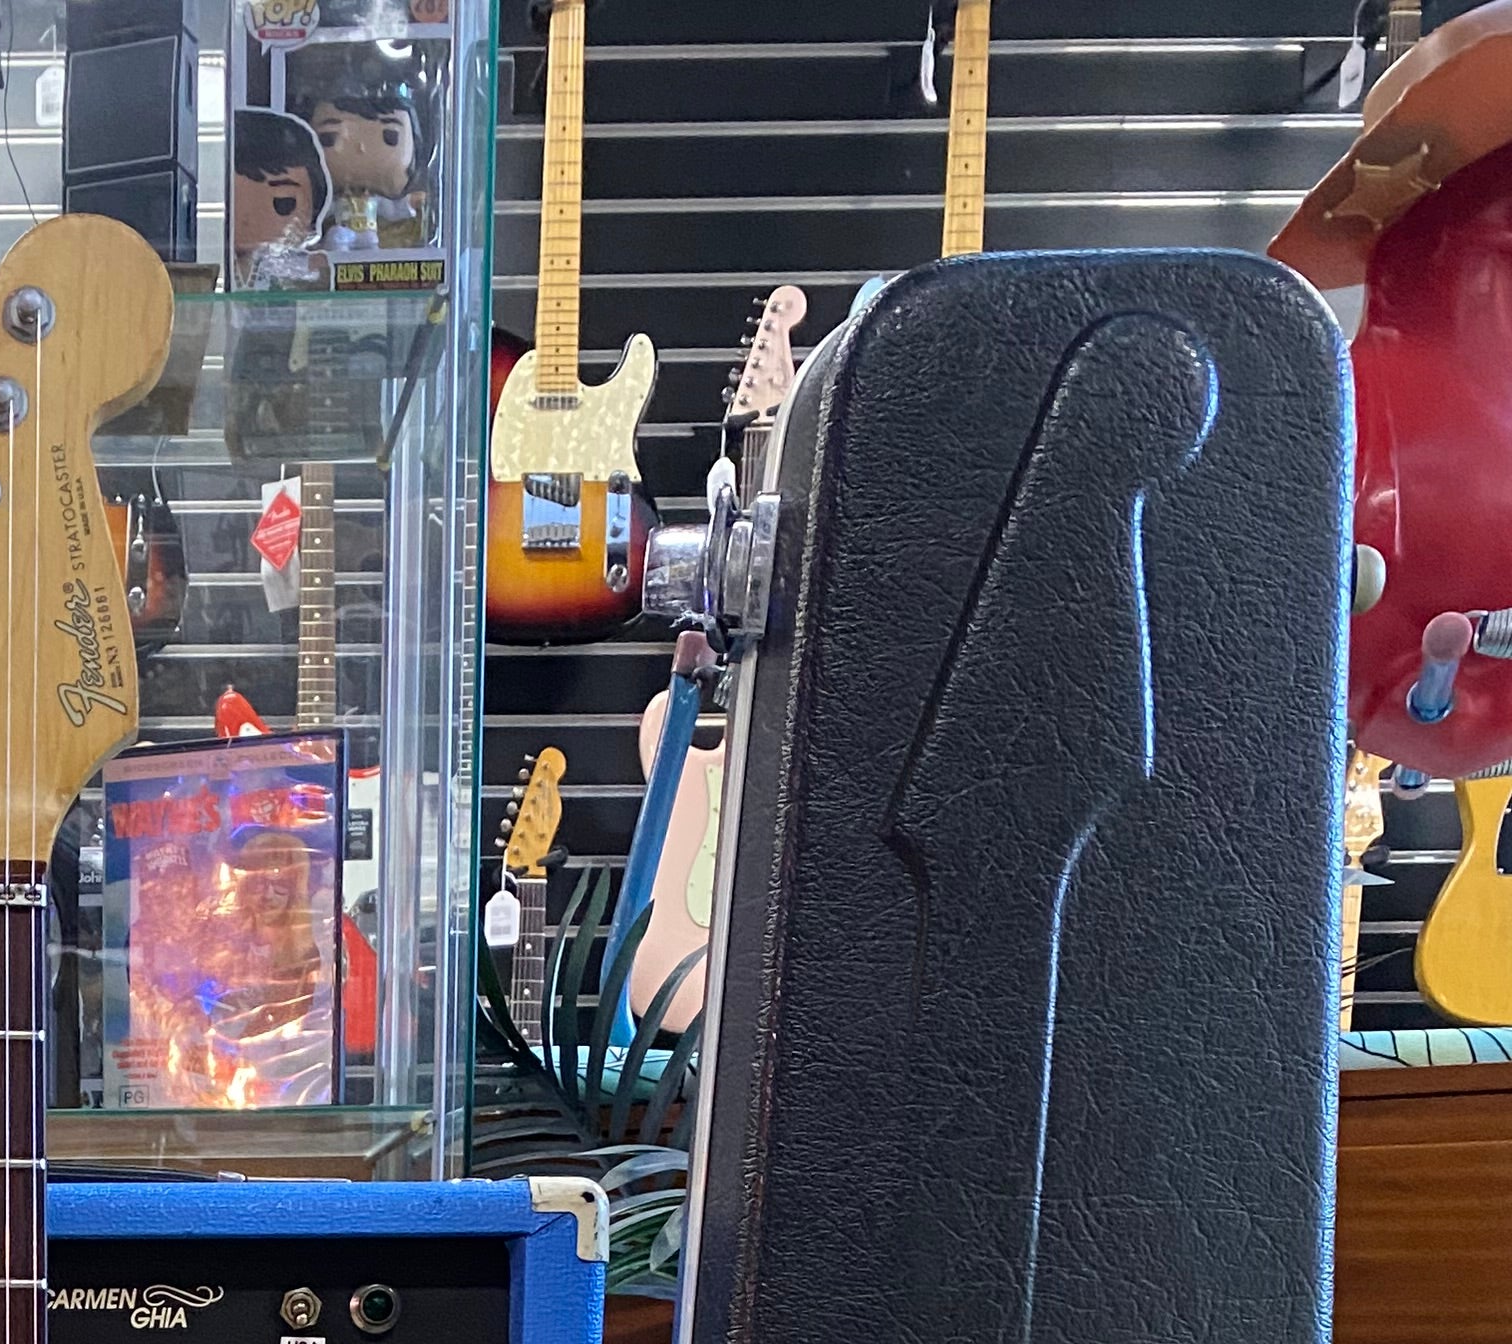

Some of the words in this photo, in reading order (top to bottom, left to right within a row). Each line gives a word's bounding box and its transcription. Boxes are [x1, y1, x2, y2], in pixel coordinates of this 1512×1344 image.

[337, 264, 364, 283] ELVIS
[369, 262, 418, 281] PHARAOH
[420, 261, 443, 280] SUIT
[51, 443, 85, 571] STRATOCASTER
[124, 1091, 145, 1104] PG
[130, 1307, 187, 1329] GHIA
